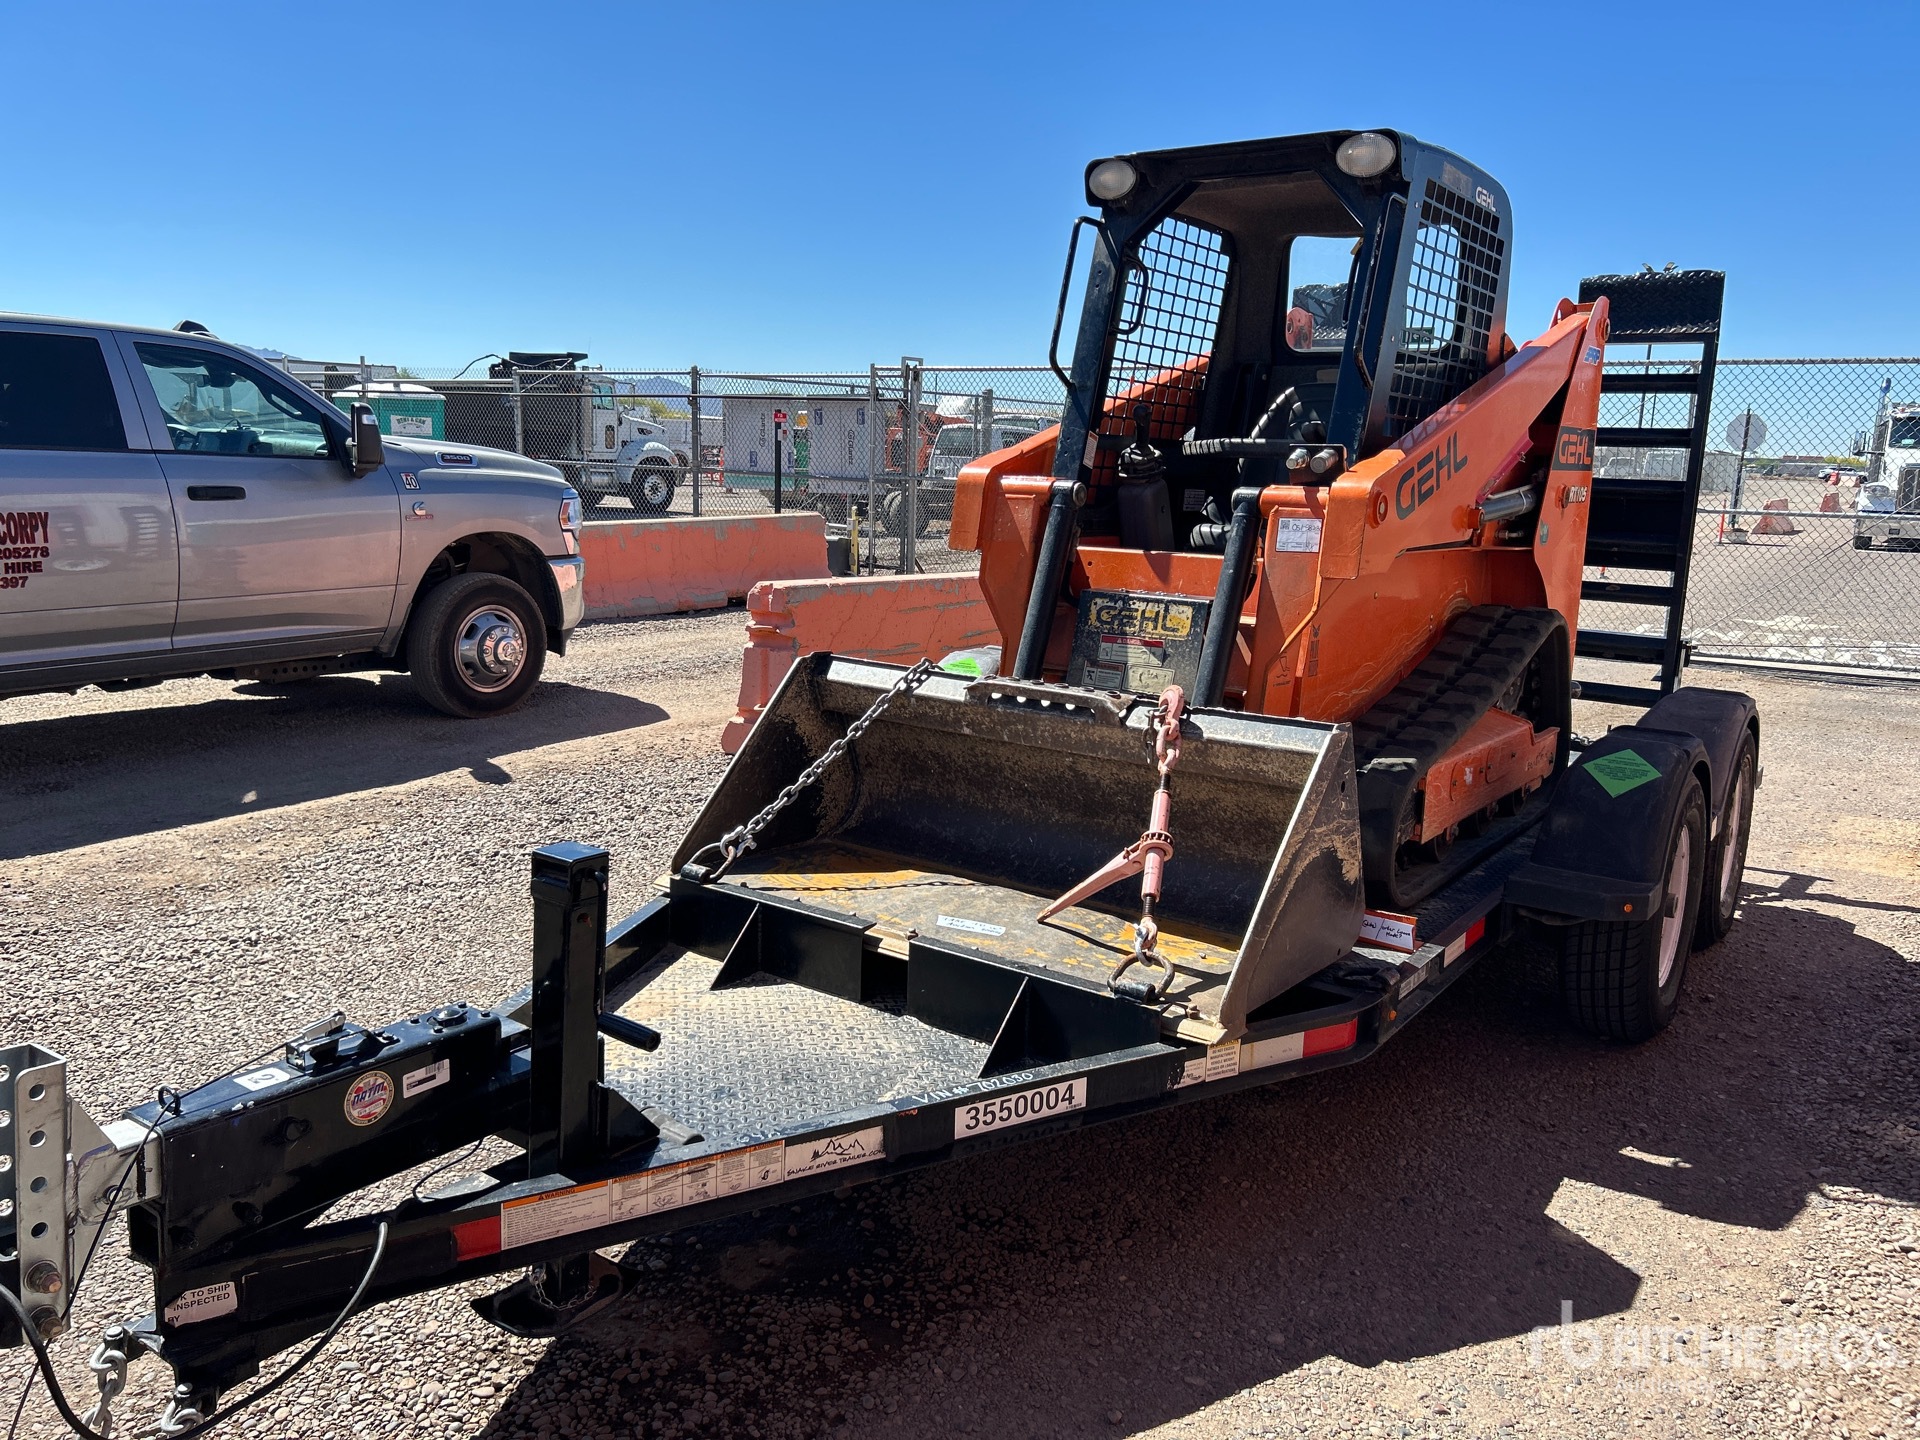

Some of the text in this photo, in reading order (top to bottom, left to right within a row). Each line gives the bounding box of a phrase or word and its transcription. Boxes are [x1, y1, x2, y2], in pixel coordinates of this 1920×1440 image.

[1476, 186, 1497, 212] GEHL
[1558, 433, 1592, 465] GEHL
[405, 476, 417, 488] 40
[1396, 431, 1468, 520] GEHL
[4, 561, 43, 574] HIRE
[1096, 602, 1180, 633] GEHL
[352, 1081, 386, 1106] NATM
[965, 1082, 1075, 1130] 3550004
[787, 1165, 814, 1177] SNAKE
[816, 1159, 838, 1169] RIVER
[839, 1152, 866, 1163] TRAILER
[544, 1188, 576, 1199] WARNING
[173, 1292, 230, 1311] INSPECTED
[190, 1290, 204, 1299] TO
[207, 1284, 230, 1295] SHIP
